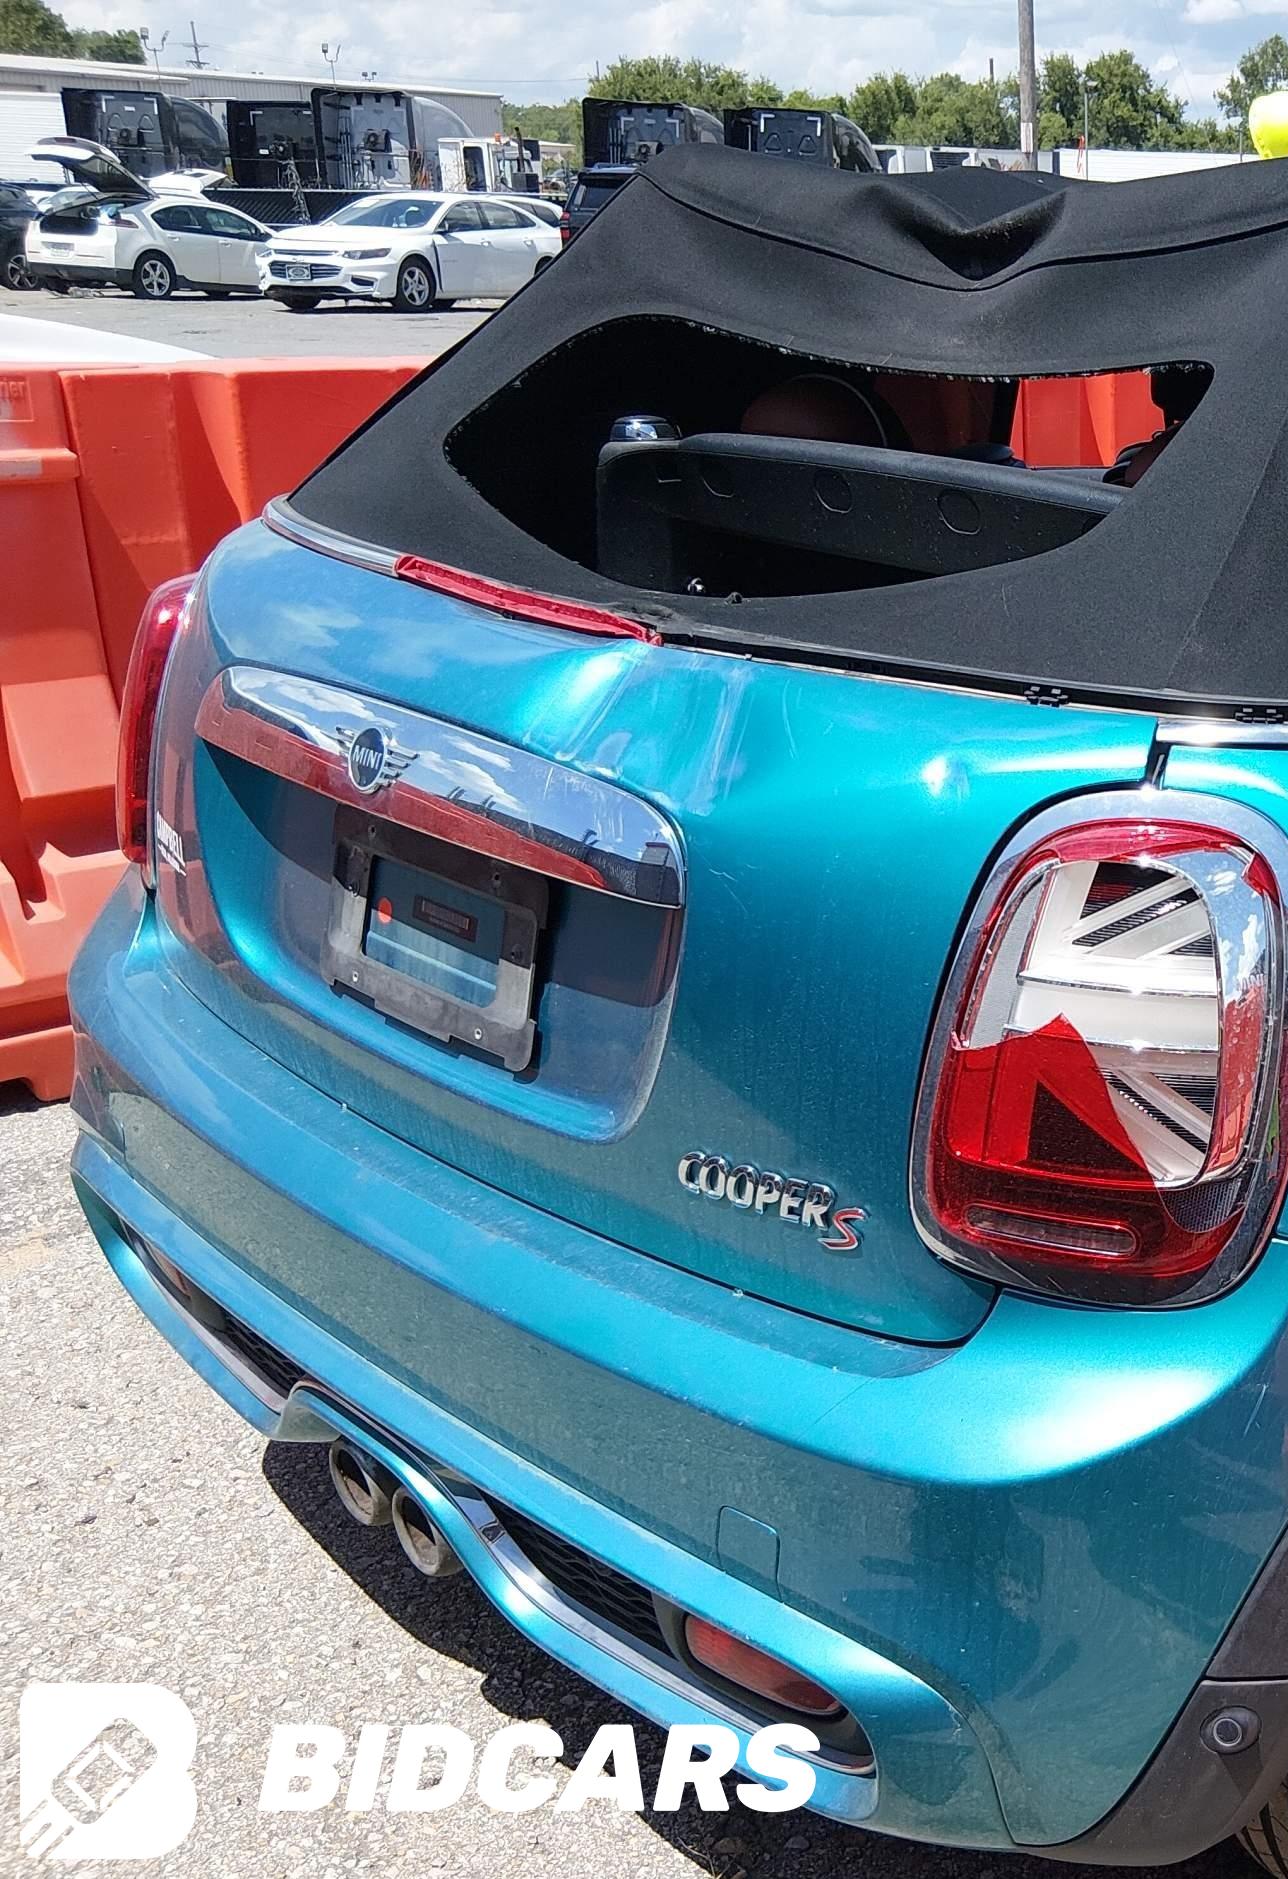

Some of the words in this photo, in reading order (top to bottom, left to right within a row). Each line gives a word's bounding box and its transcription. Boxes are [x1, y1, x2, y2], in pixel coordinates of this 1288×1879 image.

[352, 744, 382, 770] MINI
[678, 1150, 836, 1231] COOPER
[817, 1206, 868, 1250] S
